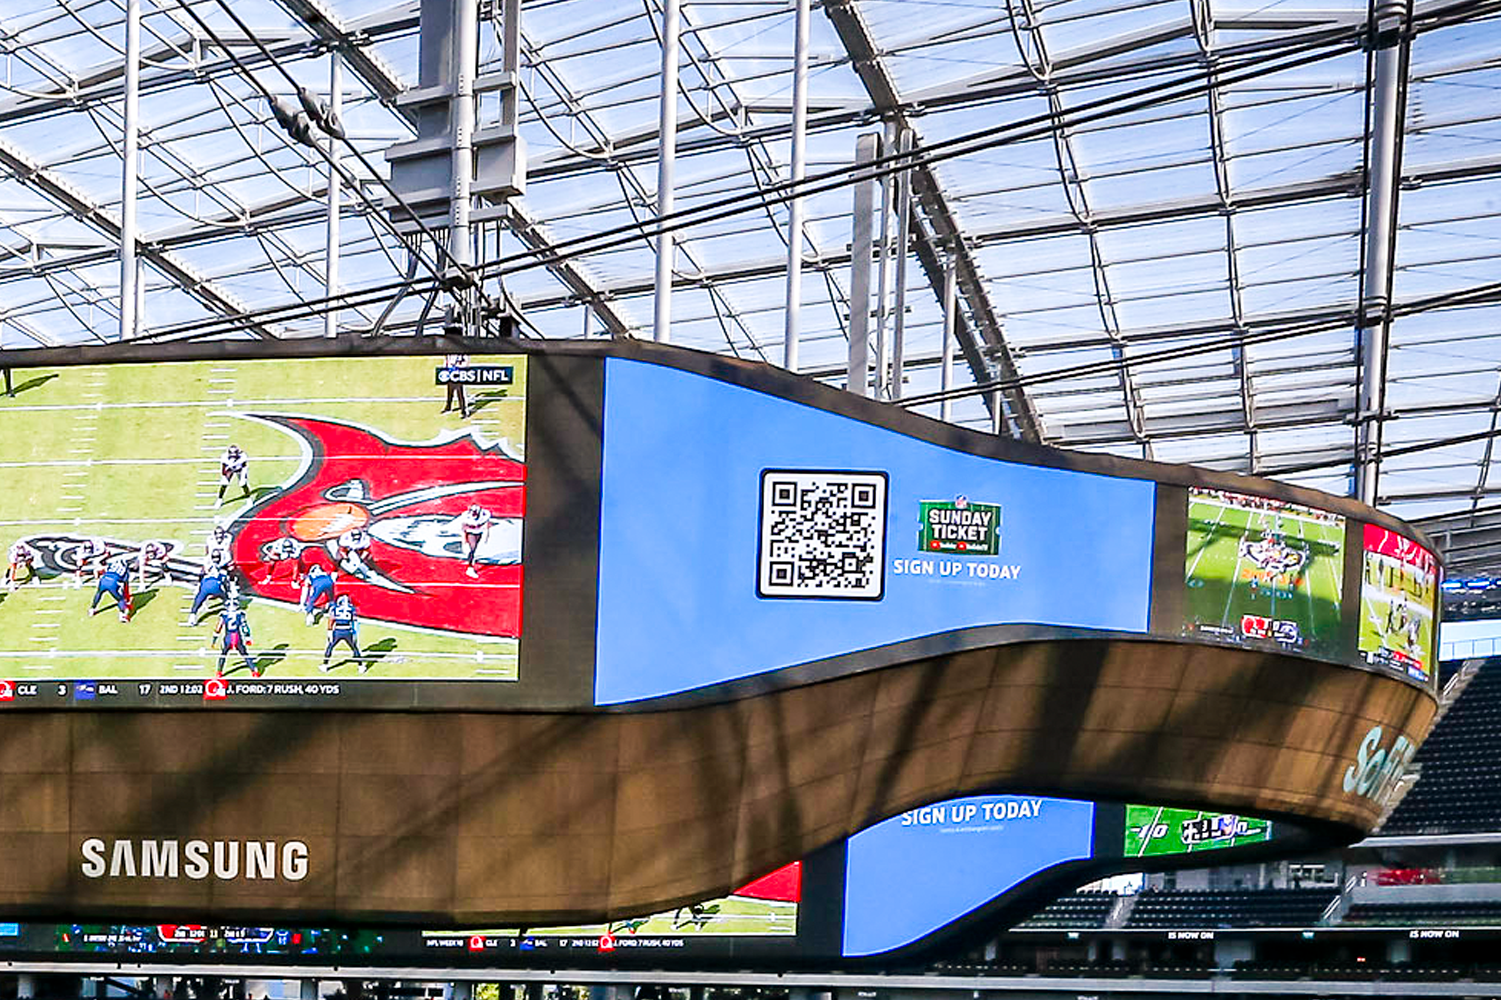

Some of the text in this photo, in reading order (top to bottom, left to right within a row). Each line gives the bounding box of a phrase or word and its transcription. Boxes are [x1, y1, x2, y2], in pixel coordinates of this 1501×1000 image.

[450, 369, 508, 382] CBS NFL
[928, 508, 992, 527] SUNDAY
[931, 523, 988, 541] TICKET
[893, 559, 1021, 580] SIGN UP TODAY
[17, 685, 38, 695] CLE
[57, 685, 67, 695] 3
[98, 685, 118, 695] BAL
[139, 684, 151, 694] 17
[159, 685, 178, 694] 2ND
[305, 684, 319, 694] 40
[320, 684, 340, 694] YDS
[901, 800, 1043, 826] SIGN UP TODAY
[81, 837, 309, 881] SAMSUNG
[1168, 931, 1214, 939] IS NOW ON
[1409, 930, 1460, 938] IS NOW ON
